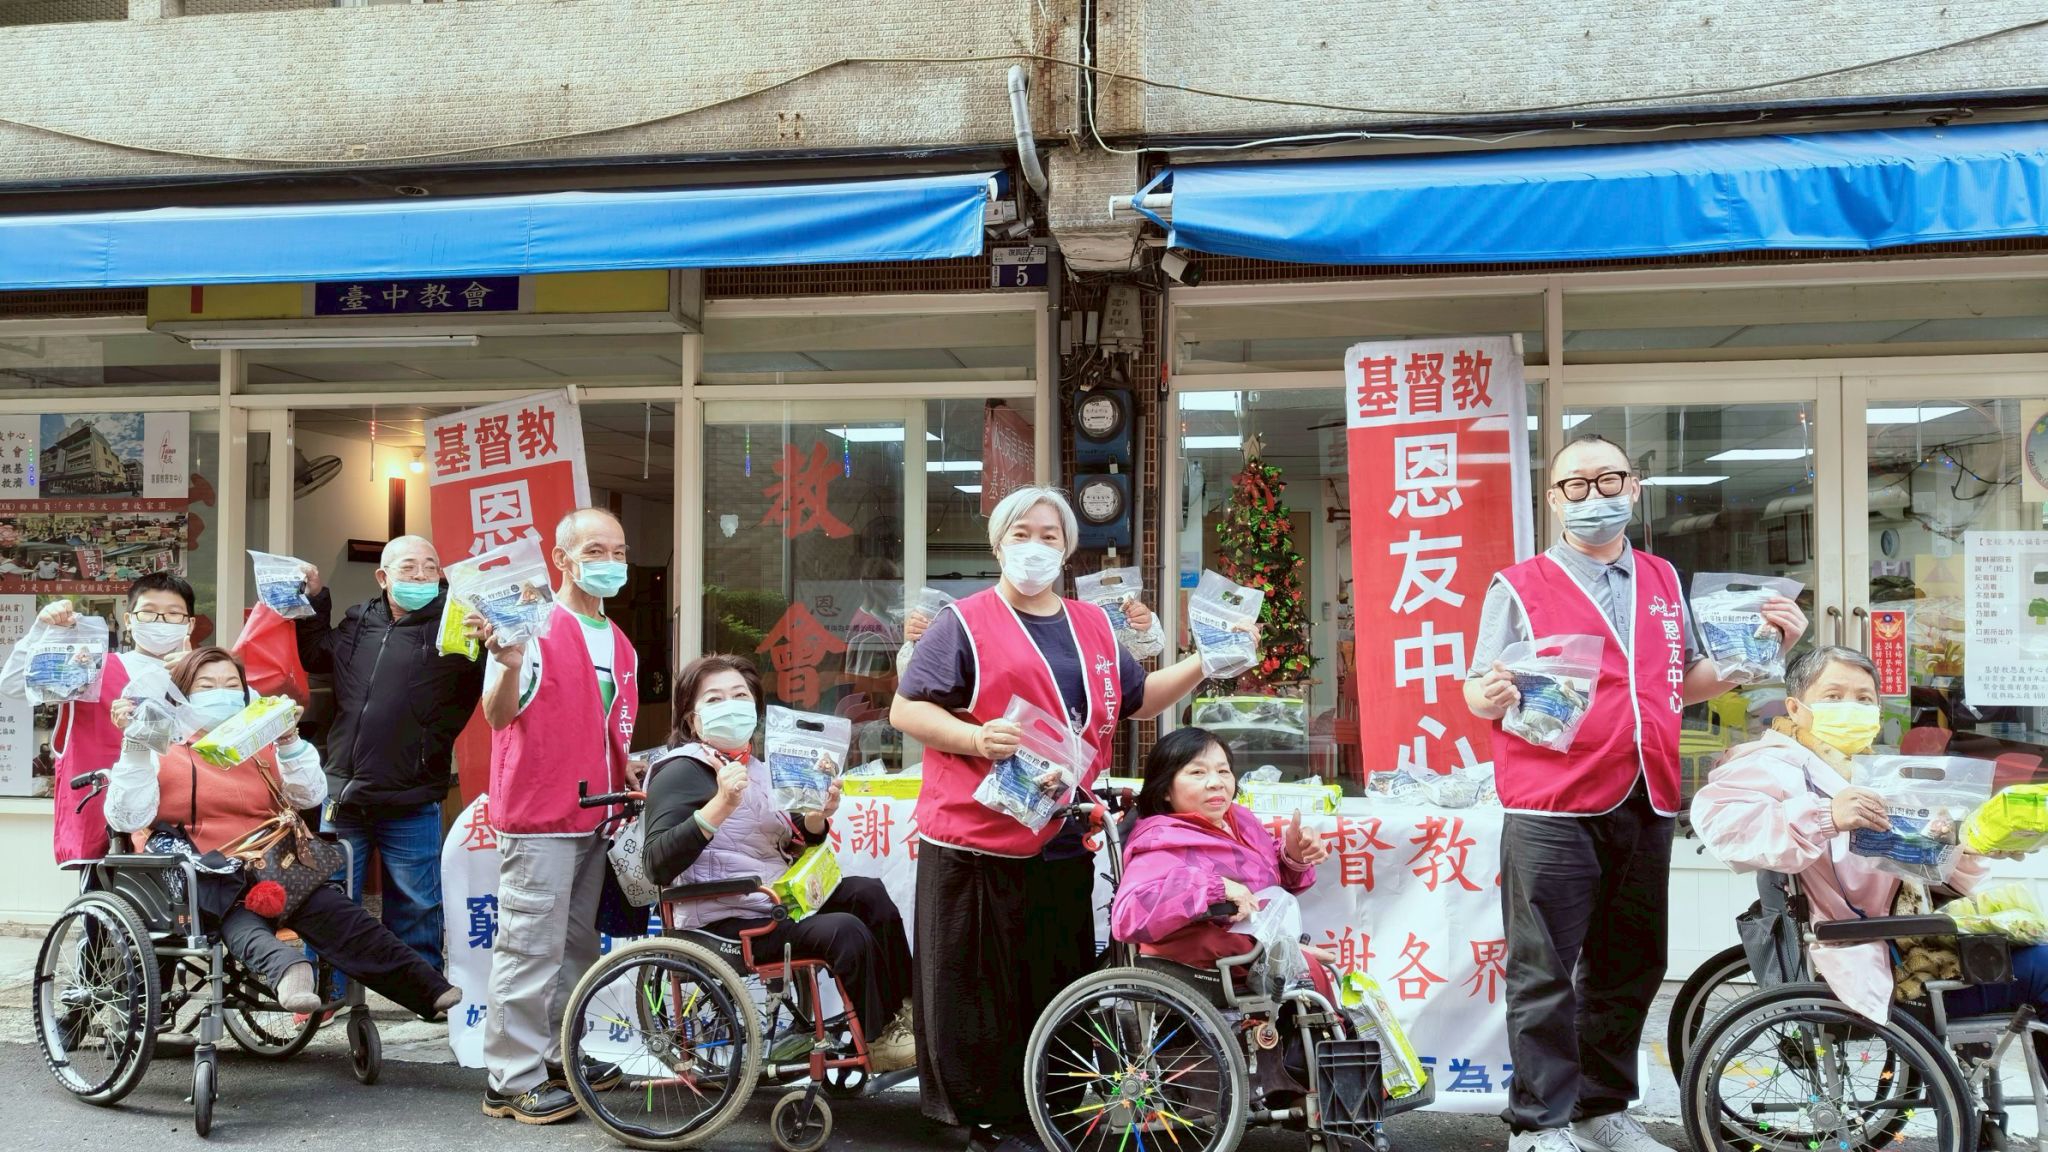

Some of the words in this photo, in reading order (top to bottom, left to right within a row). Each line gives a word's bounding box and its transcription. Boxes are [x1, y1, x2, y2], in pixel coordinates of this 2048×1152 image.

[338, 280, 494, 313] 臺中教會
[1016, 265, 1029, 287] 5
[1357, 349, 1493, 419] 基督教
[433, 404, 559, 477] 基督教
[755, 441, 855, 707] 教會
[1387, 432, 1480, 774] 恩友中心
[1661, 620, 1684, 715] 恩友中心
